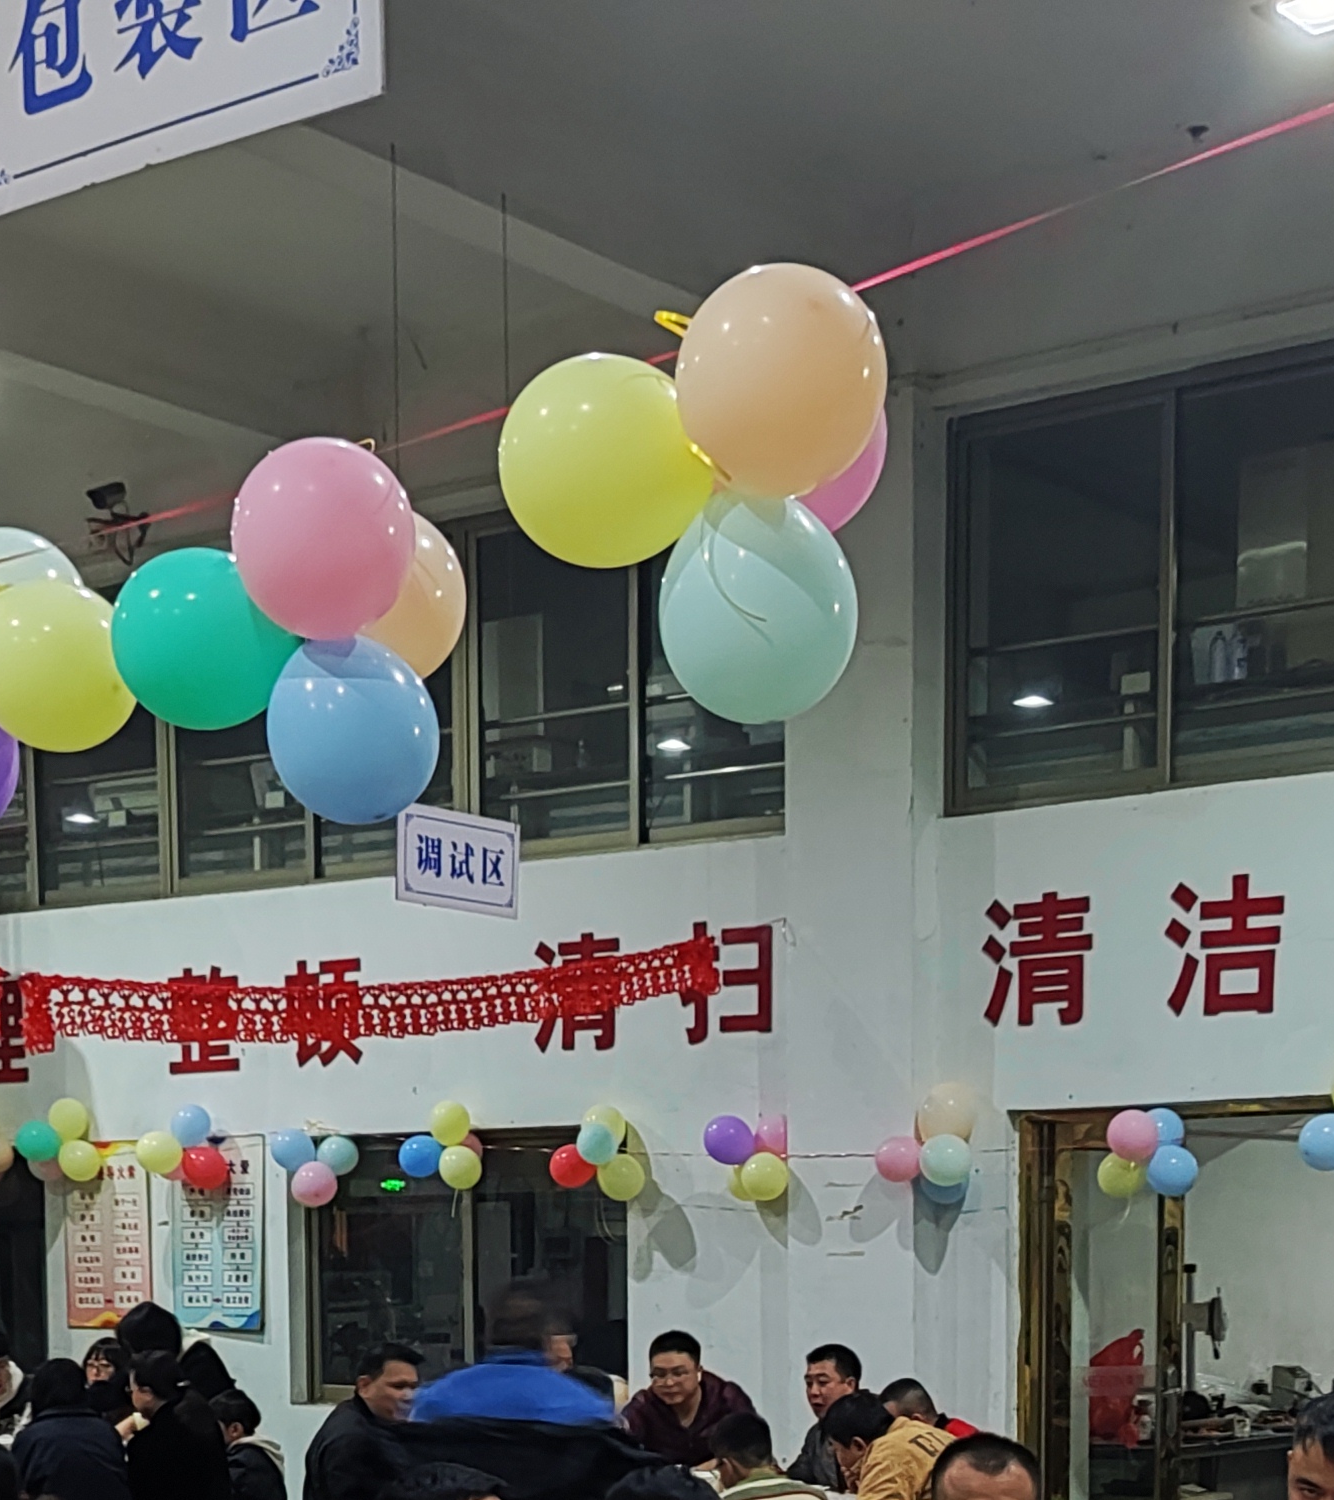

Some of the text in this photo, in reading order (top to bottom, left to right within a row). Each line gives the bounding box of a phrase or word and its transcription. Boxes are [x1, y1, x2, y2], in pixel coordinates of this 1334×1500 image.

[8, 0, 320, 115] 包装
[416, 833, 505, 887] 调试区
[981, 873, 1286, 1027] 清洁
